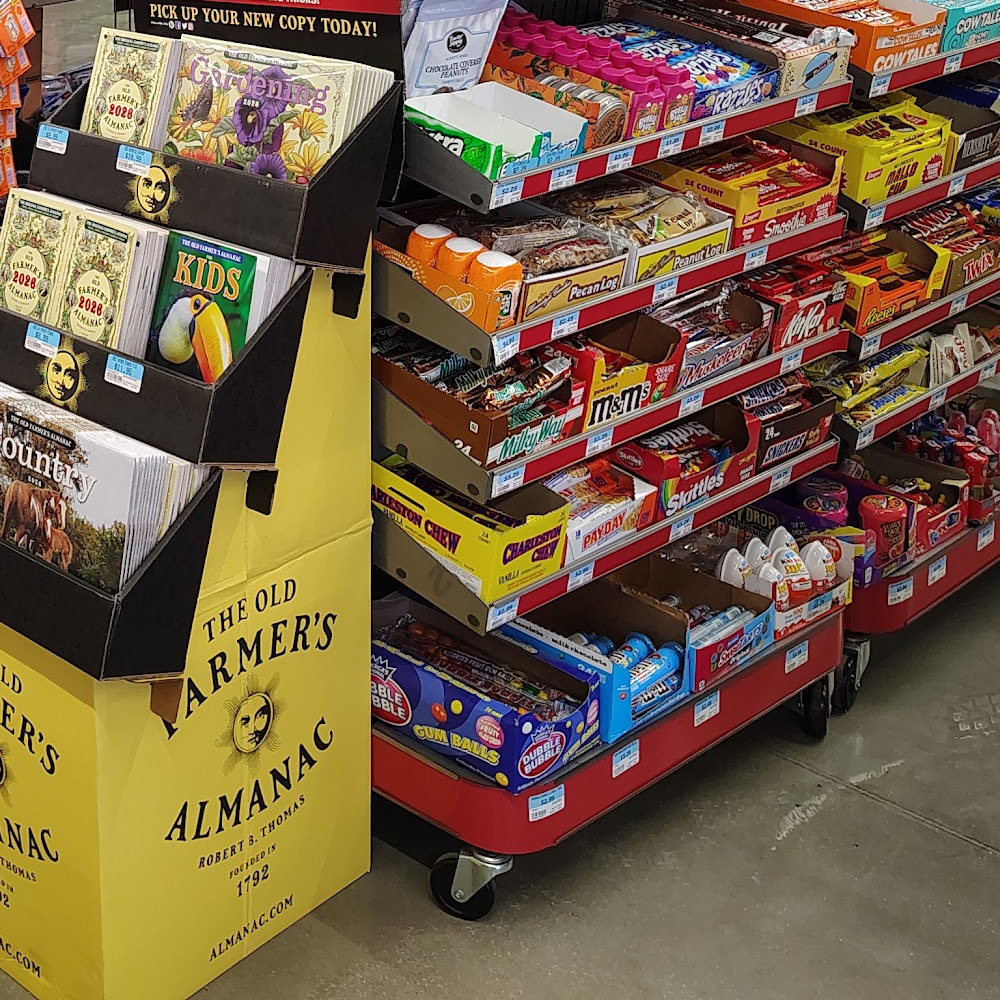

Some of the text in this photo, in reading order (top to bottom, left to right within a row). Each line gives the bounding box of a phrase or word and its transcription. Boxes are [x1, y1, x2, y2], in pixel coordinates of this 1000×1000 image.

[149, 3, 378, 38] PICK UP YOUR NEW COPY TODAY!
[425, 57, 482, 73] CHOCOLATE COVERED
[440, 68, 469, 80] PEANUTS
[188, 56, 330, 115] Gardening
[808, 138, 847, 156] 24 COUNT
[962, 133, 993, 159] HERSHEY'S
[502, 186, 518, 194] $2.29
[684, 178, 724, 197] 24 COUNT
[672, 243, 723, 270] Peanut Log
[173, 251, 242, 301] KIDS
[568, 276, 619, 301] Pecan Log
[655, 364, 675, 376] SHARE
[656, 374, 673, 384] SIZE
[666, 471, 724, 516] Skittles
[481, 530, 490, 539] 24
[581, 509, 627, 552] PAYDAY
[502, 524, 562, 565] CHARLESTON
[202, 578, 297, 644] THE OLD
[413, 725, 500, 766] GUM BALLS
[480, 726, 499, 739] FRUIT
[522, 736, 561, 764] DUBBLE
[524, 746, 561, 774] BUBBLE
[164, 716, 334, 843] ALMANAC
[198, 794, 306, 870] ROBERT B. THOMAS
[1, 856, 37, 882] THOMAS
[236, 864, 270, 899] 1792
[6, 883, 15, 893] IN
[209, 894, 294, 963] ALMANAC.COM
